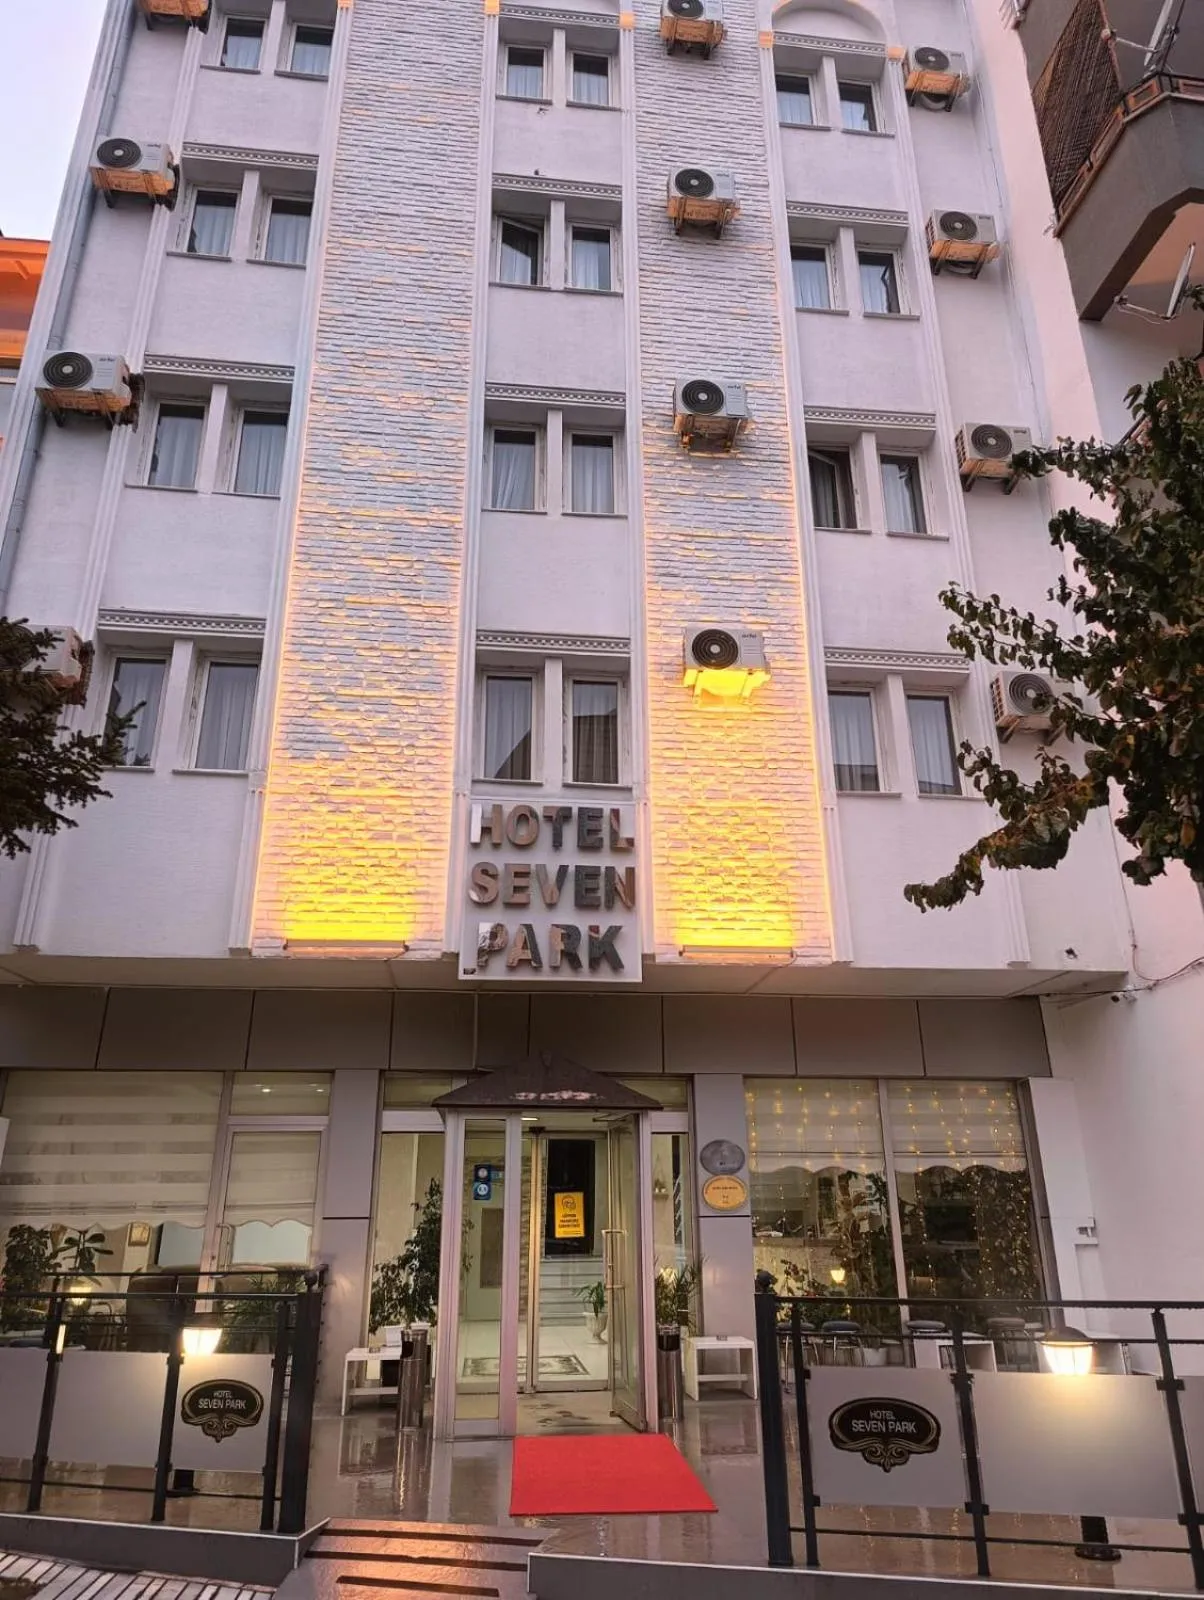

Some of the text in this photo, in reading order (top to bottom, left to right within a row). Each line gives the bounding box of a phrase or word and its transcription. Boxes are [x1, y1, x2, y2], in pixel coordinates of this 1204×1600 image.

[470, 803, 635, 850] HOTEL
[468, 862, 636, 909] SEVEN
[477, 923, 624, 970] PARK
[213, 1390, 232, 1398] HOTEL
[198, 1399, 246, 1409] SEVEN PARK
[869, 1410, 896, 1420] HOTEL
[852, 1420, 917, 1433] SEVEN PARK
